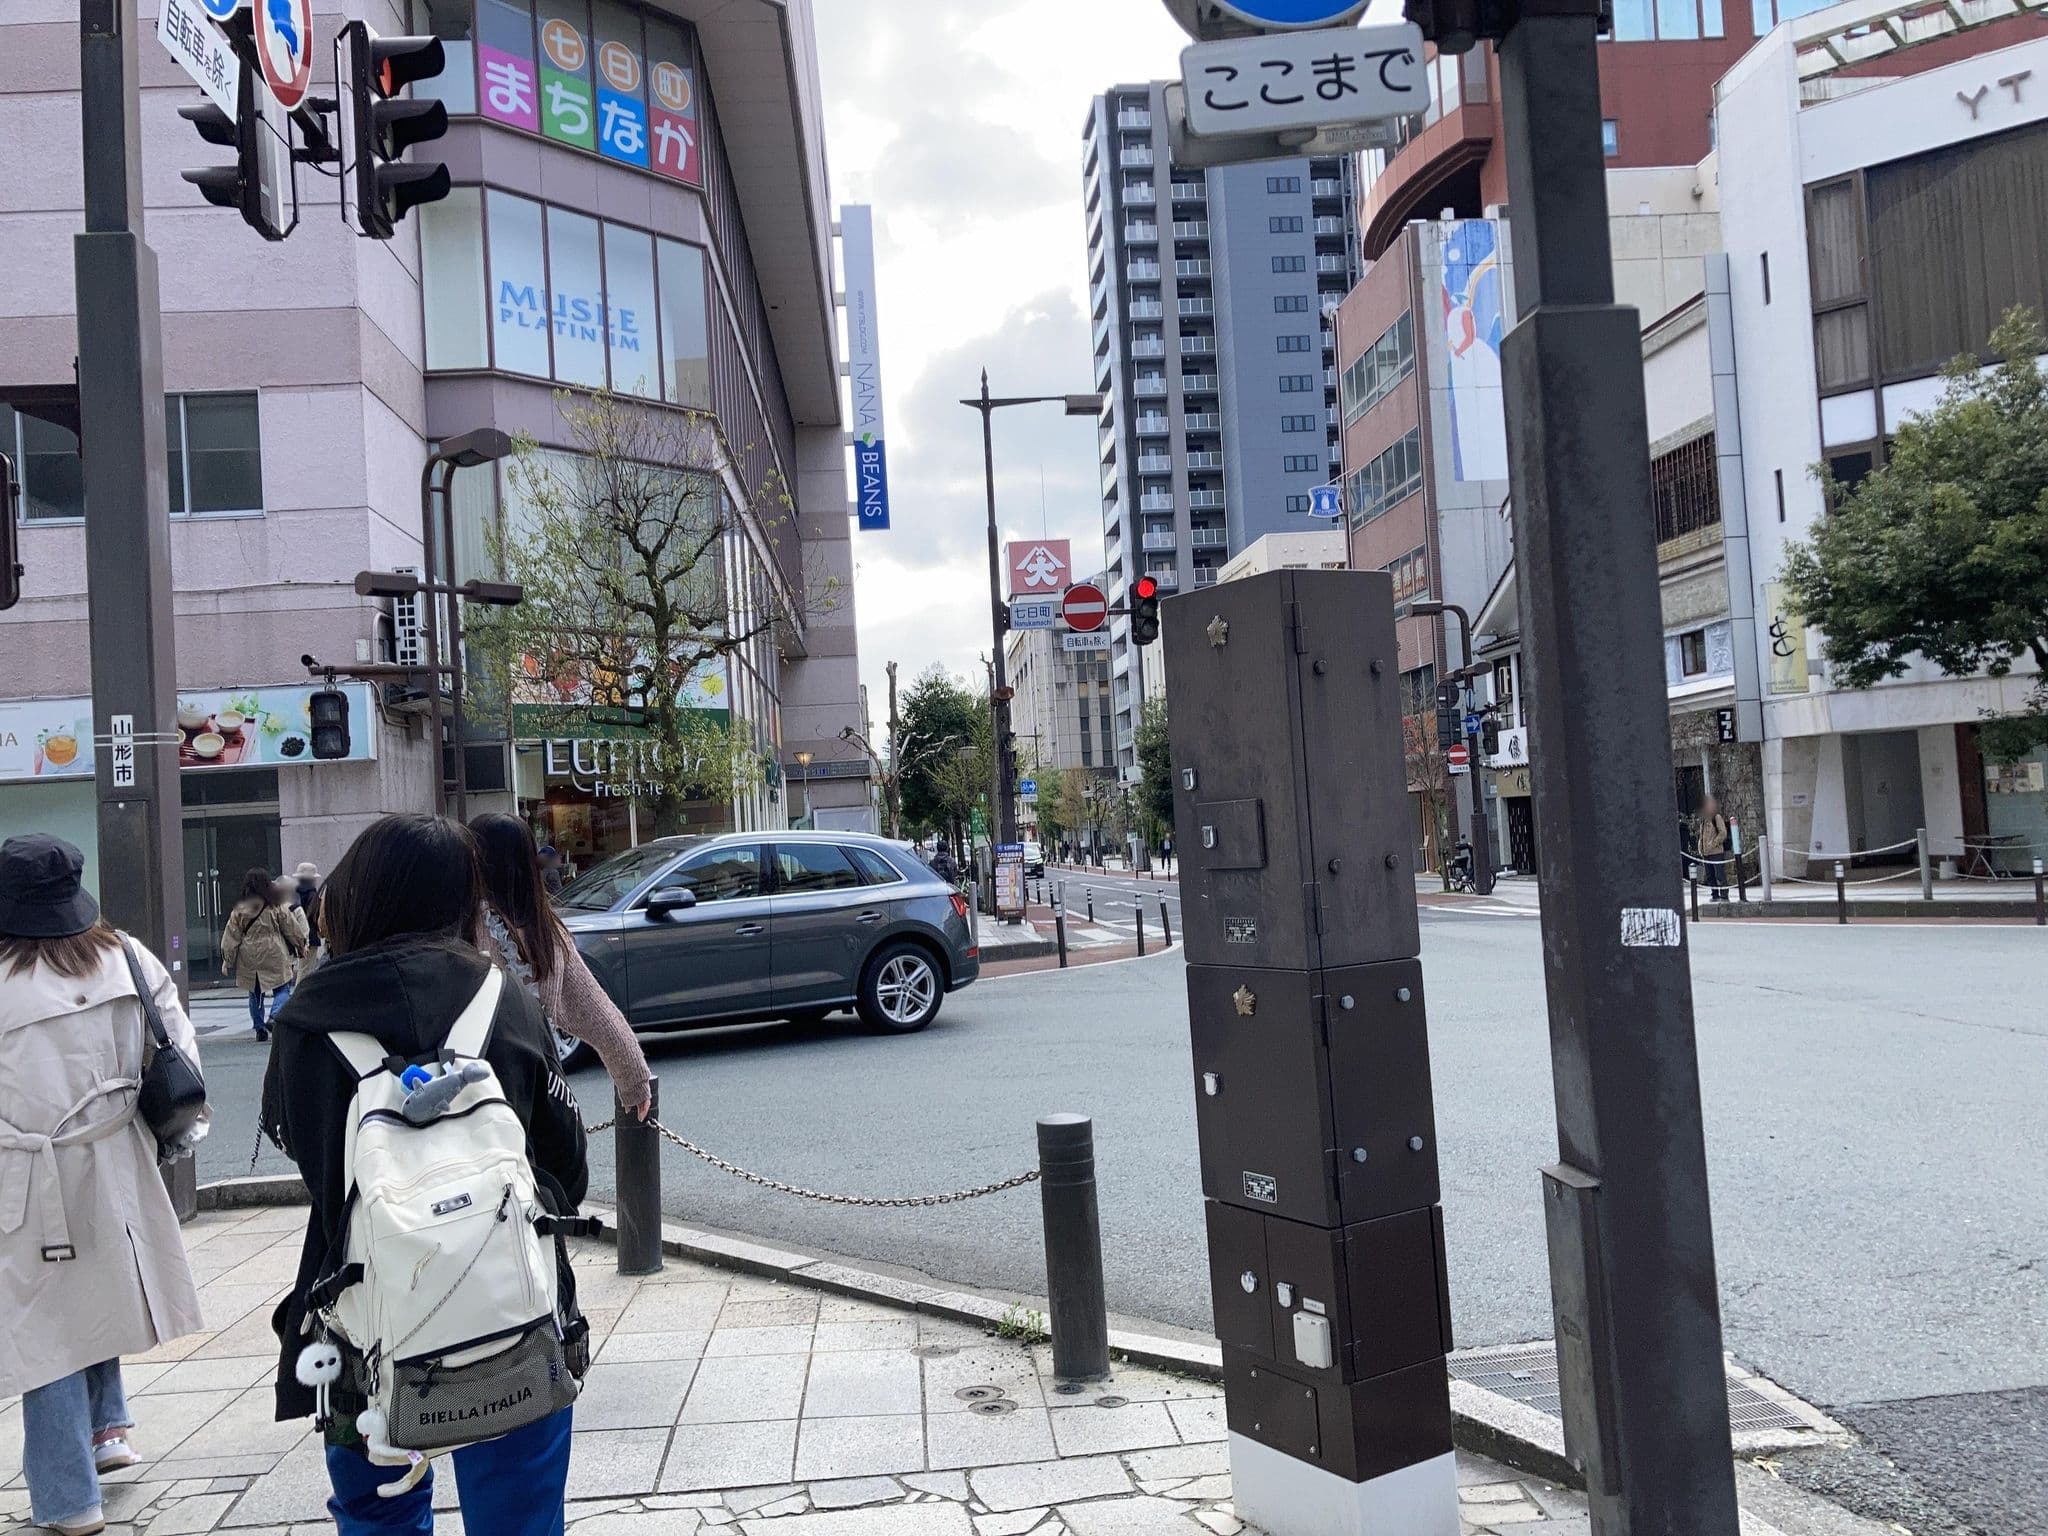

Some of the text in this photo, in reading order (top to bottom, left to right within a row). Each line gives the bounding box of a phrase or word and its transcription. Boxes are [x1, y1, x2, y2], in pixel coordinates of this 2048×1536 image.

[166, 0, 232, 101] 自転車を除く
[550, 27, 684, 103] 七日町
[1205, 47, 1415, 110] ここまで
[485, 61, 694, 171] まちなか
[501, 308, 640, 352] PLATINUM
[856, 363, 877, 427] NANA
[862, 452, 882, 518] BEANS
[1014, 606, 1051, 619] 七日町
[113, 719, 133, 783] 山形市
[594, 780, 642, 798] Fresh
[420, 1386, 533, 1426] BIELLA ITALIA
